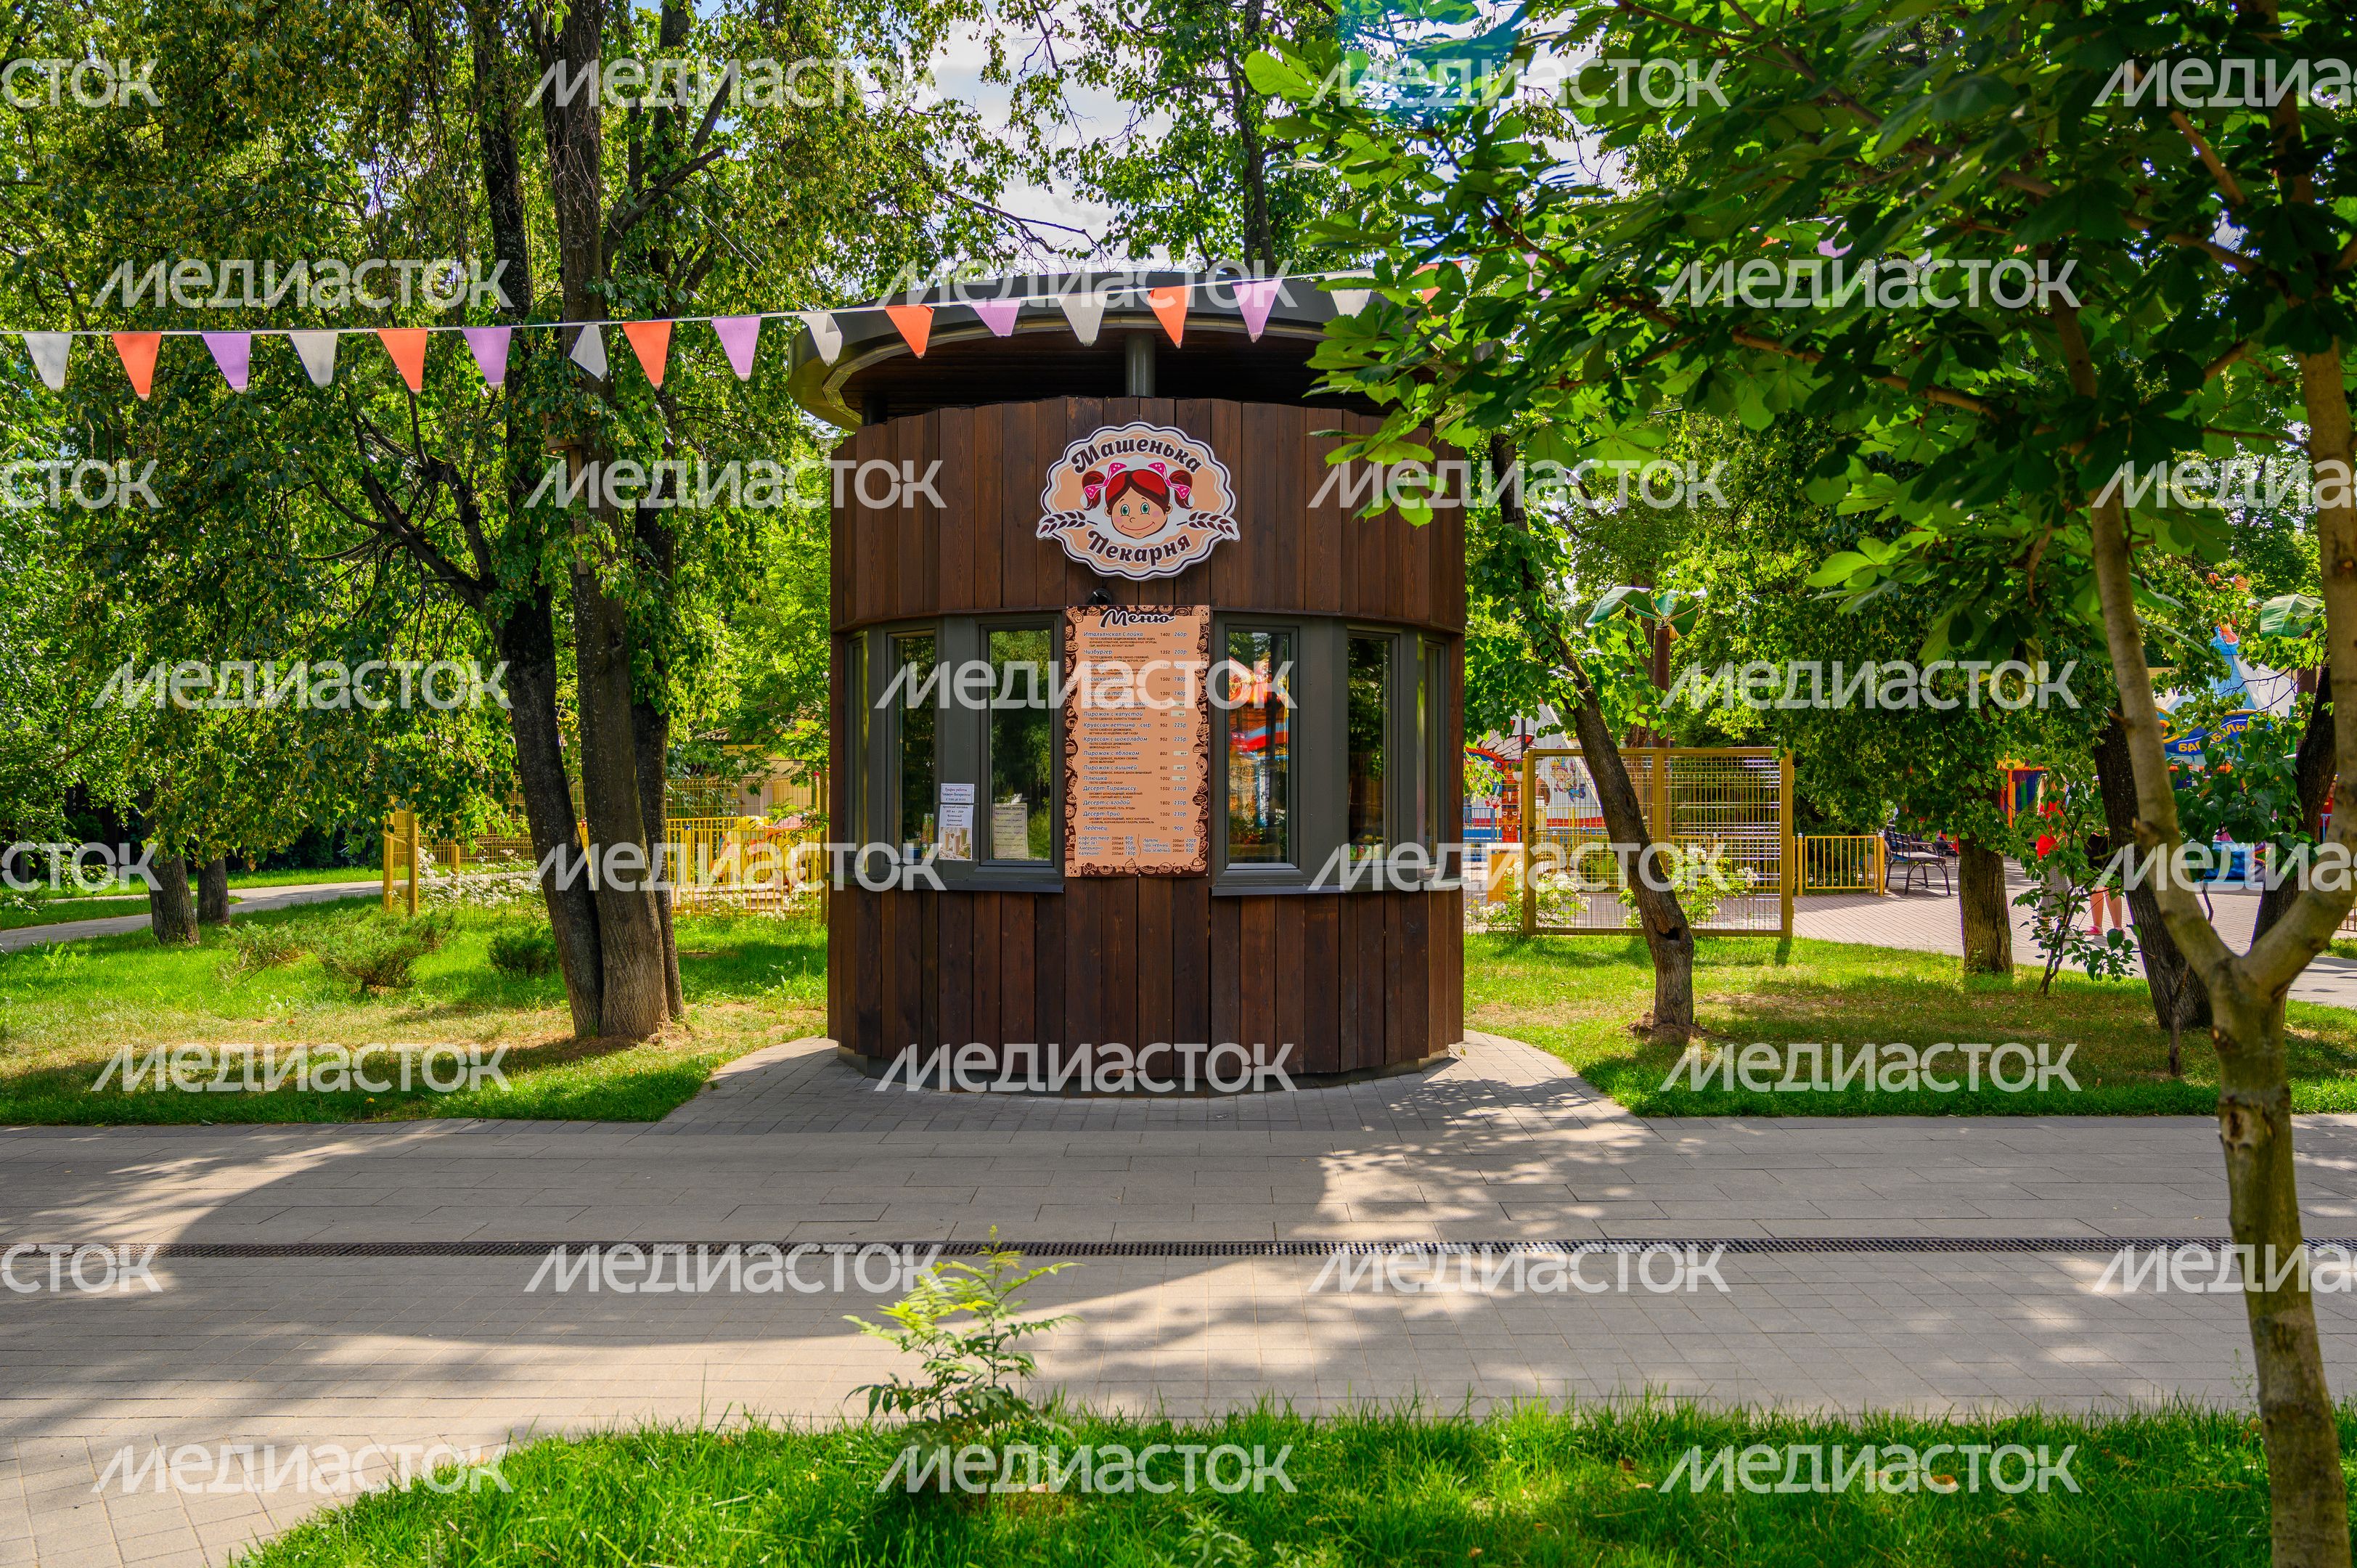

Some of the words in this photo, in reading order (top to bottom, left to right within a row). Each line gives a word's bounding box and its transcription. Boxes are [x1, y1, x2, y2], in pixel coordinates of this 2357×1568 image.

[1071, 438, 1201, 473] Машенька
[1087, 531, 1190, 566] Пекарня
[1100, 610, 1175, 628] Меню
